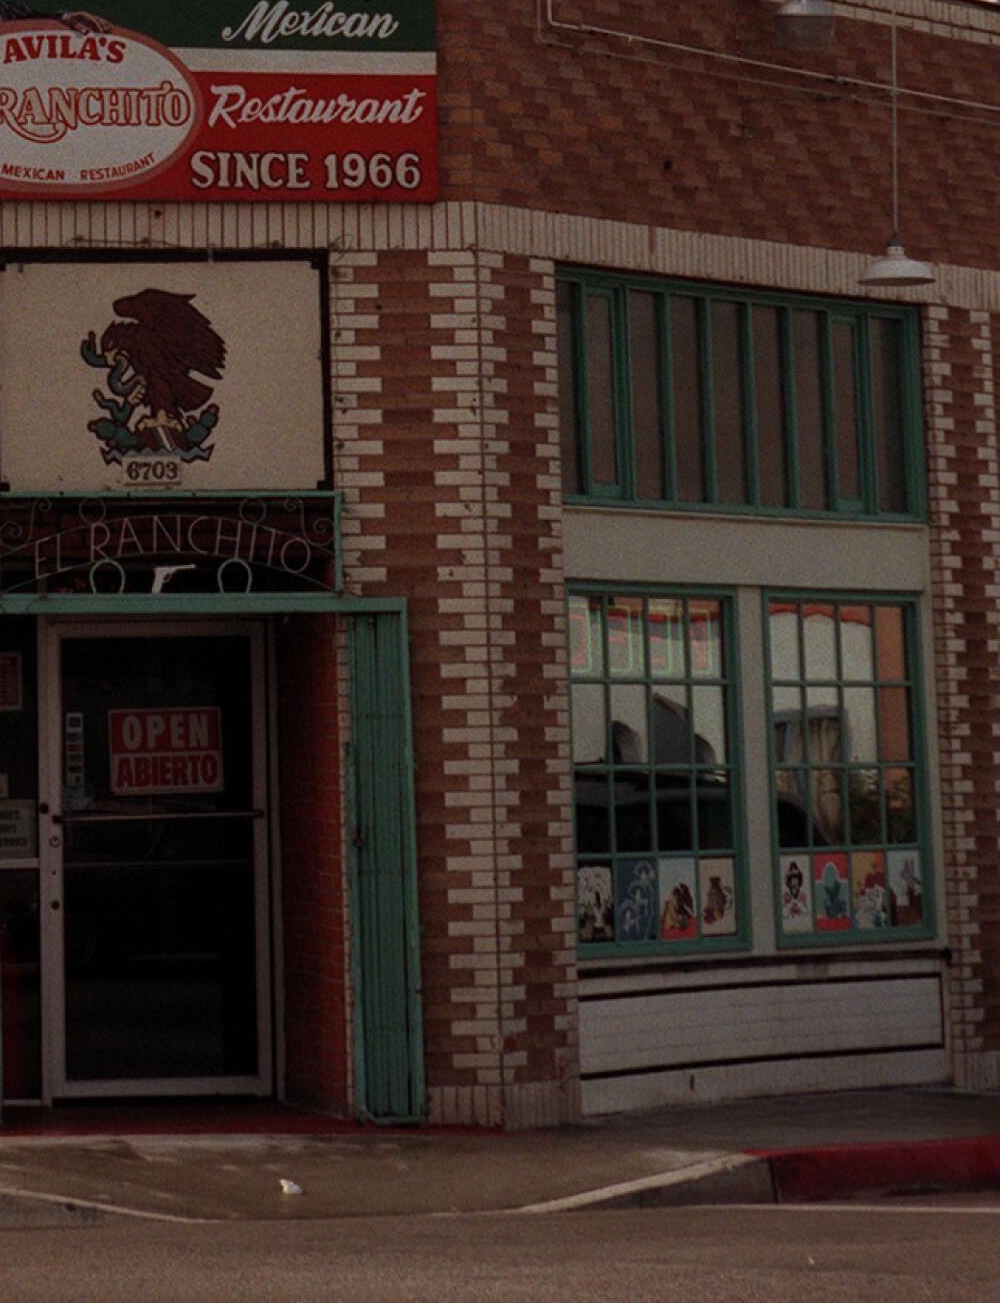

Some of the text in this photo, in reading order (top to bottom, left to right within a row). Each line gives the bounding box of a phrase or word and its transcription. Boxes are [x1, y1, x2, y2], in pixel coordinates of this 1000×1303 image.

[3, 33, 127, 65] AVILA'S
[208, 84, 427, 130] Restaurant
[1, 162, 66, 181] MEXICAN
[79, 152, 157, 181] RESTAURANT
[190, 150, 422, 190] SINCE 1966
[125, 460, 180, 481] 6703
[34, 514, 311, 581] EL RANCHITO
[120, 713, 210, 750] OPEN
[115, 753, 219, 789] ABIERTO
